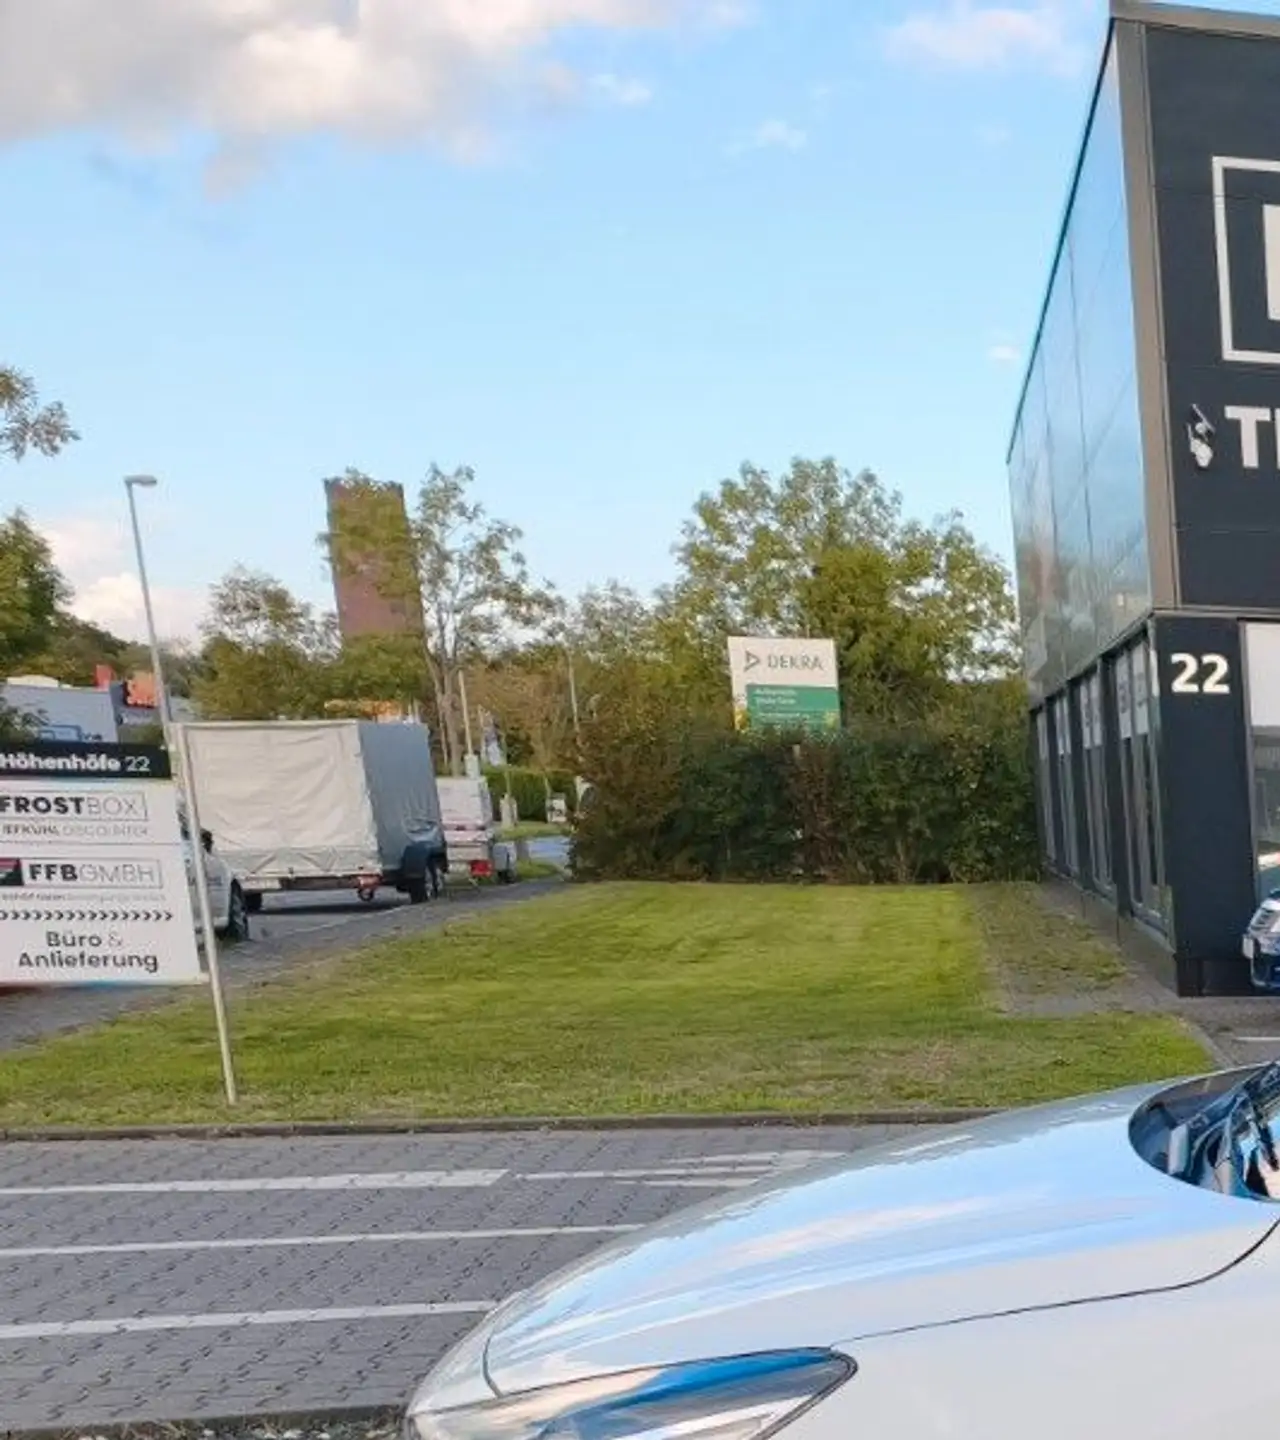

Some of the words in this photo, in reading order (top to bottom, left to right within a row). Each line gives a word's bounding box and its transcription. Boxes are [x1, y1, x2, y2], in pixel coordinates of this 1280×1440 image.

[767, 654, 824, 671] DEKRA
[1170, 652, 1230, 694] 22
[125, 755, 150, 772] 22
[0, 796, 138, 816] FROSTBOX
[46, 930, 103, 948] Büro
[18, 950, 159, 973] Anlieferung
